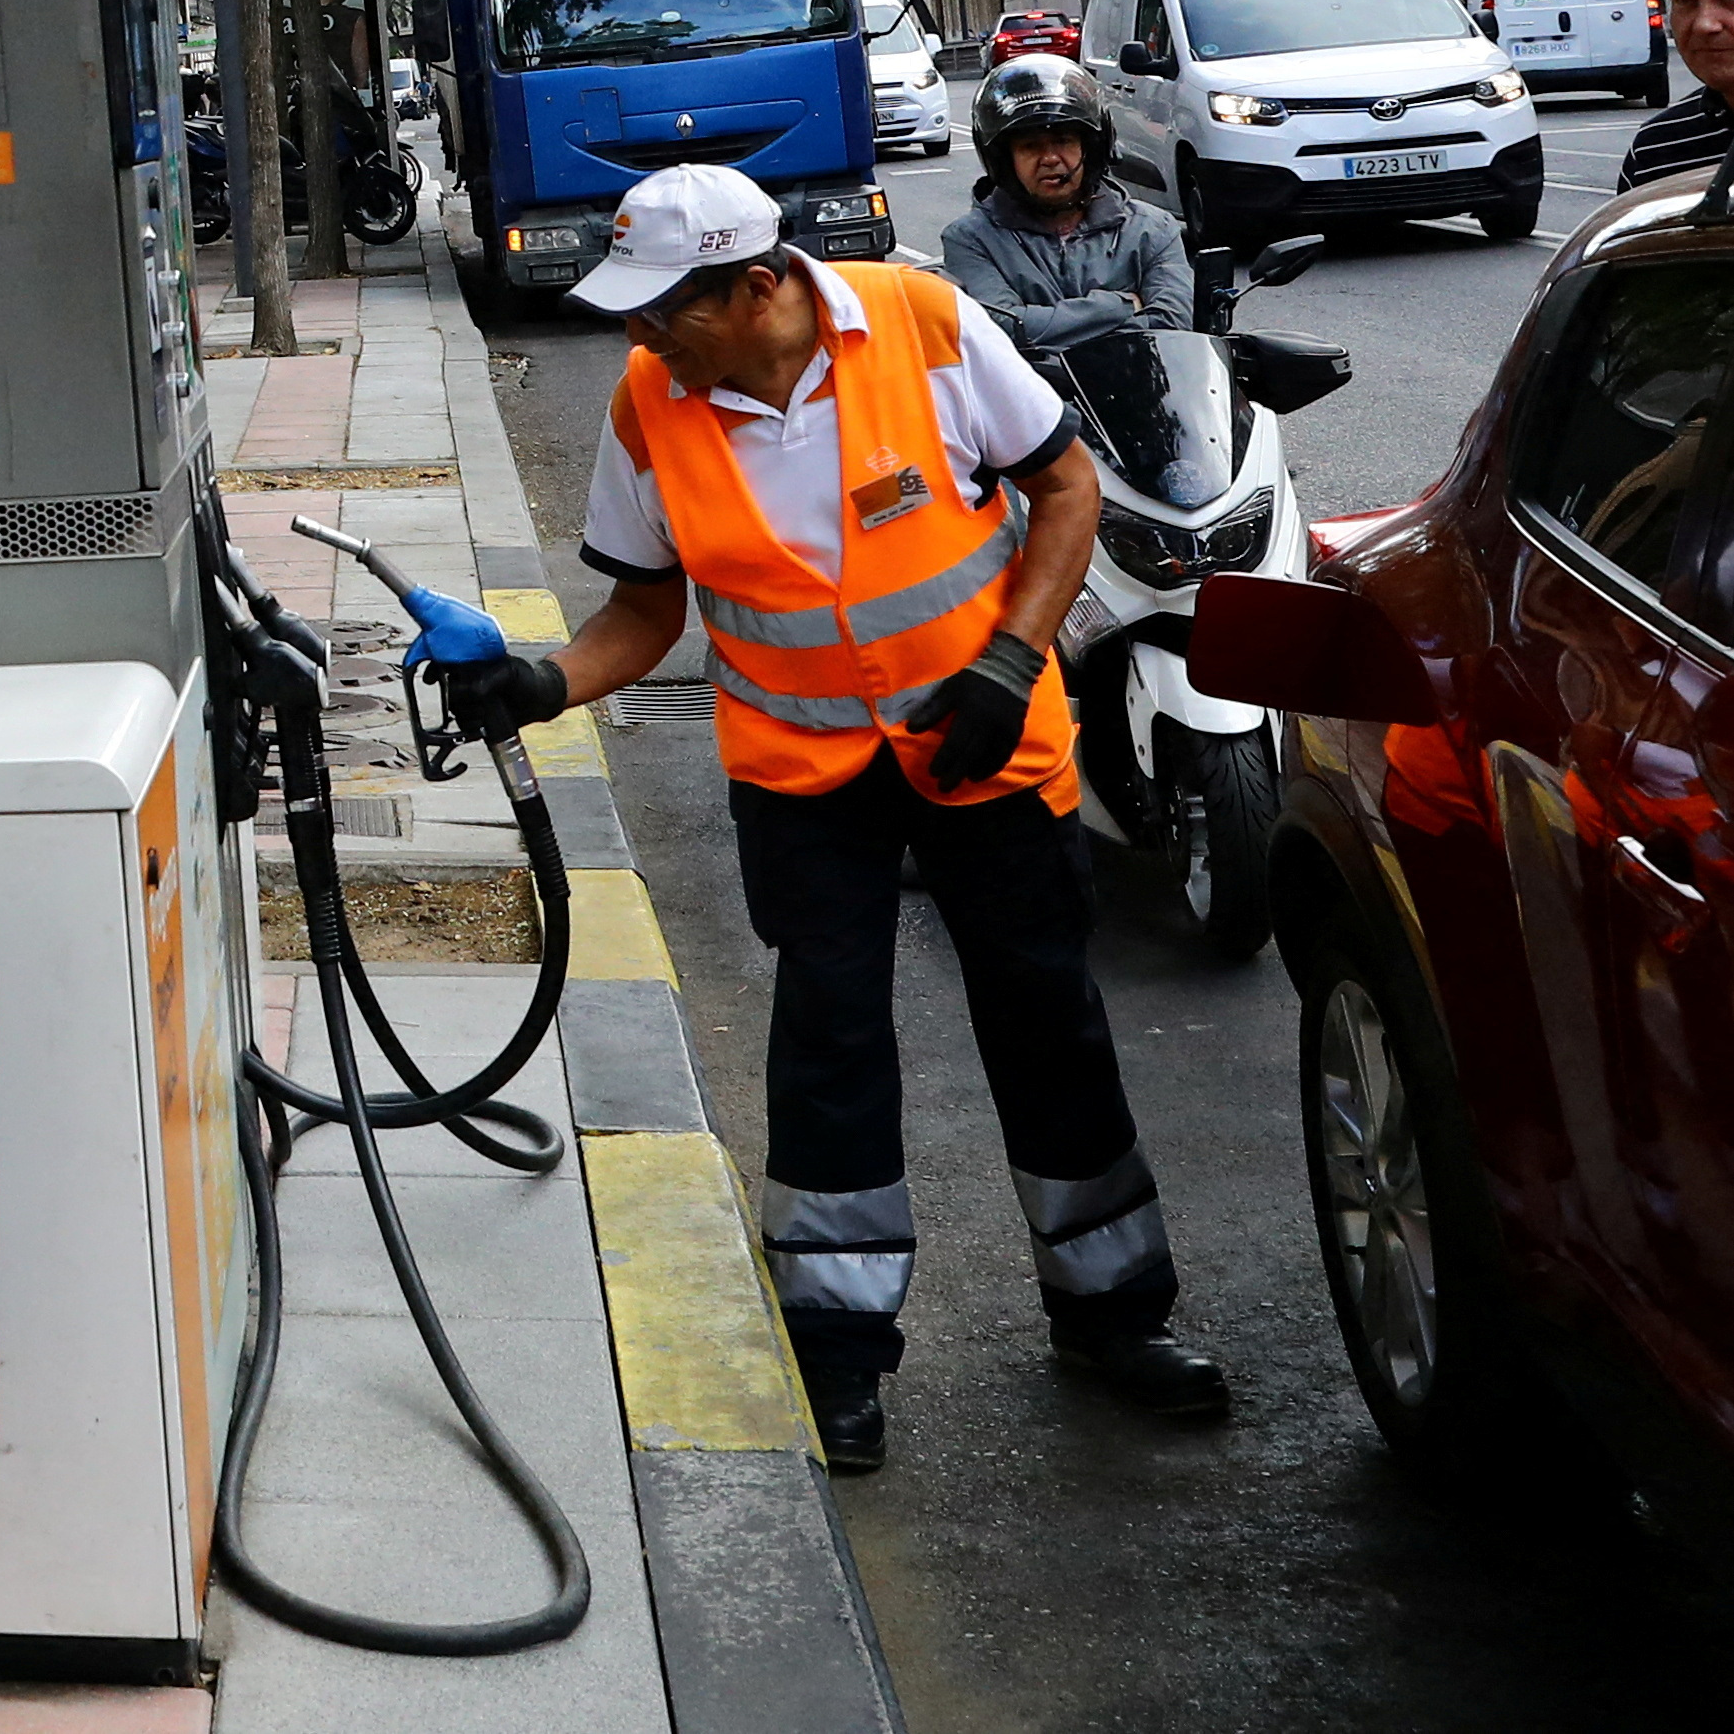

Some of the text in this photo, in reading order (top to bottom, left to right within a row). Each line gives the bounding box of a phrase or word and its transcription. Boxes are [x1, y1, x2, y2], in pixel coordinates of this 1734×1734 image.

[1355, 153, 1439, 176] 4223 LTV
[699, 228, 738, 253] 93
